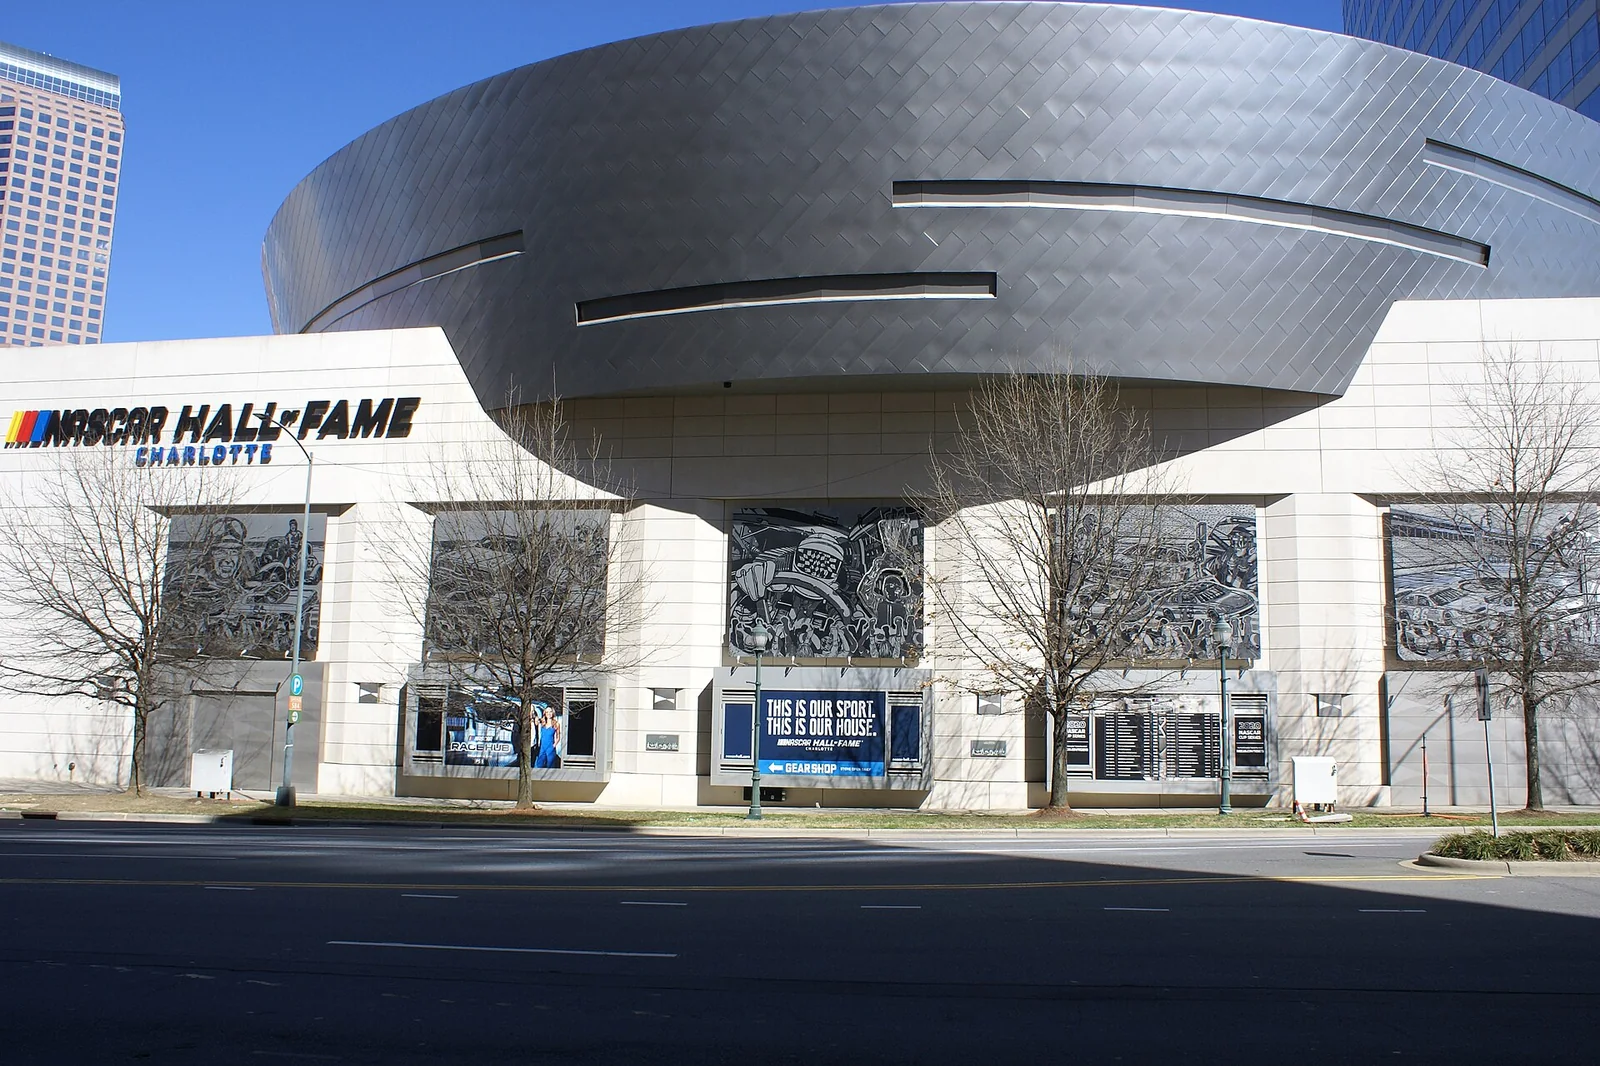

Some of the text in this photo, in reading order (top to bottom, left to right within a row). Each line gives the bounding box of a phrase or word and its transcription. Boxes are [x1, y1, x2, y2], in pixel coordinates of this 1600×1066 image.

[41, 406, 168, 447] NASCAR
[172, 402, 281, 443] HALL
[298, 397, 421, 440] FAME
[136, 443, 273, 467] CHARLOTTE
[766, 699, 876, 718] THIS IS OUR SPORT.
[766, 717, 877, 737] THIS IS OUR HOUSE.
[451, 742, 511, 752] RACE HUB
[783, 738, 812, 746] NASCAR
[812, 739, 835, 747] HALL
